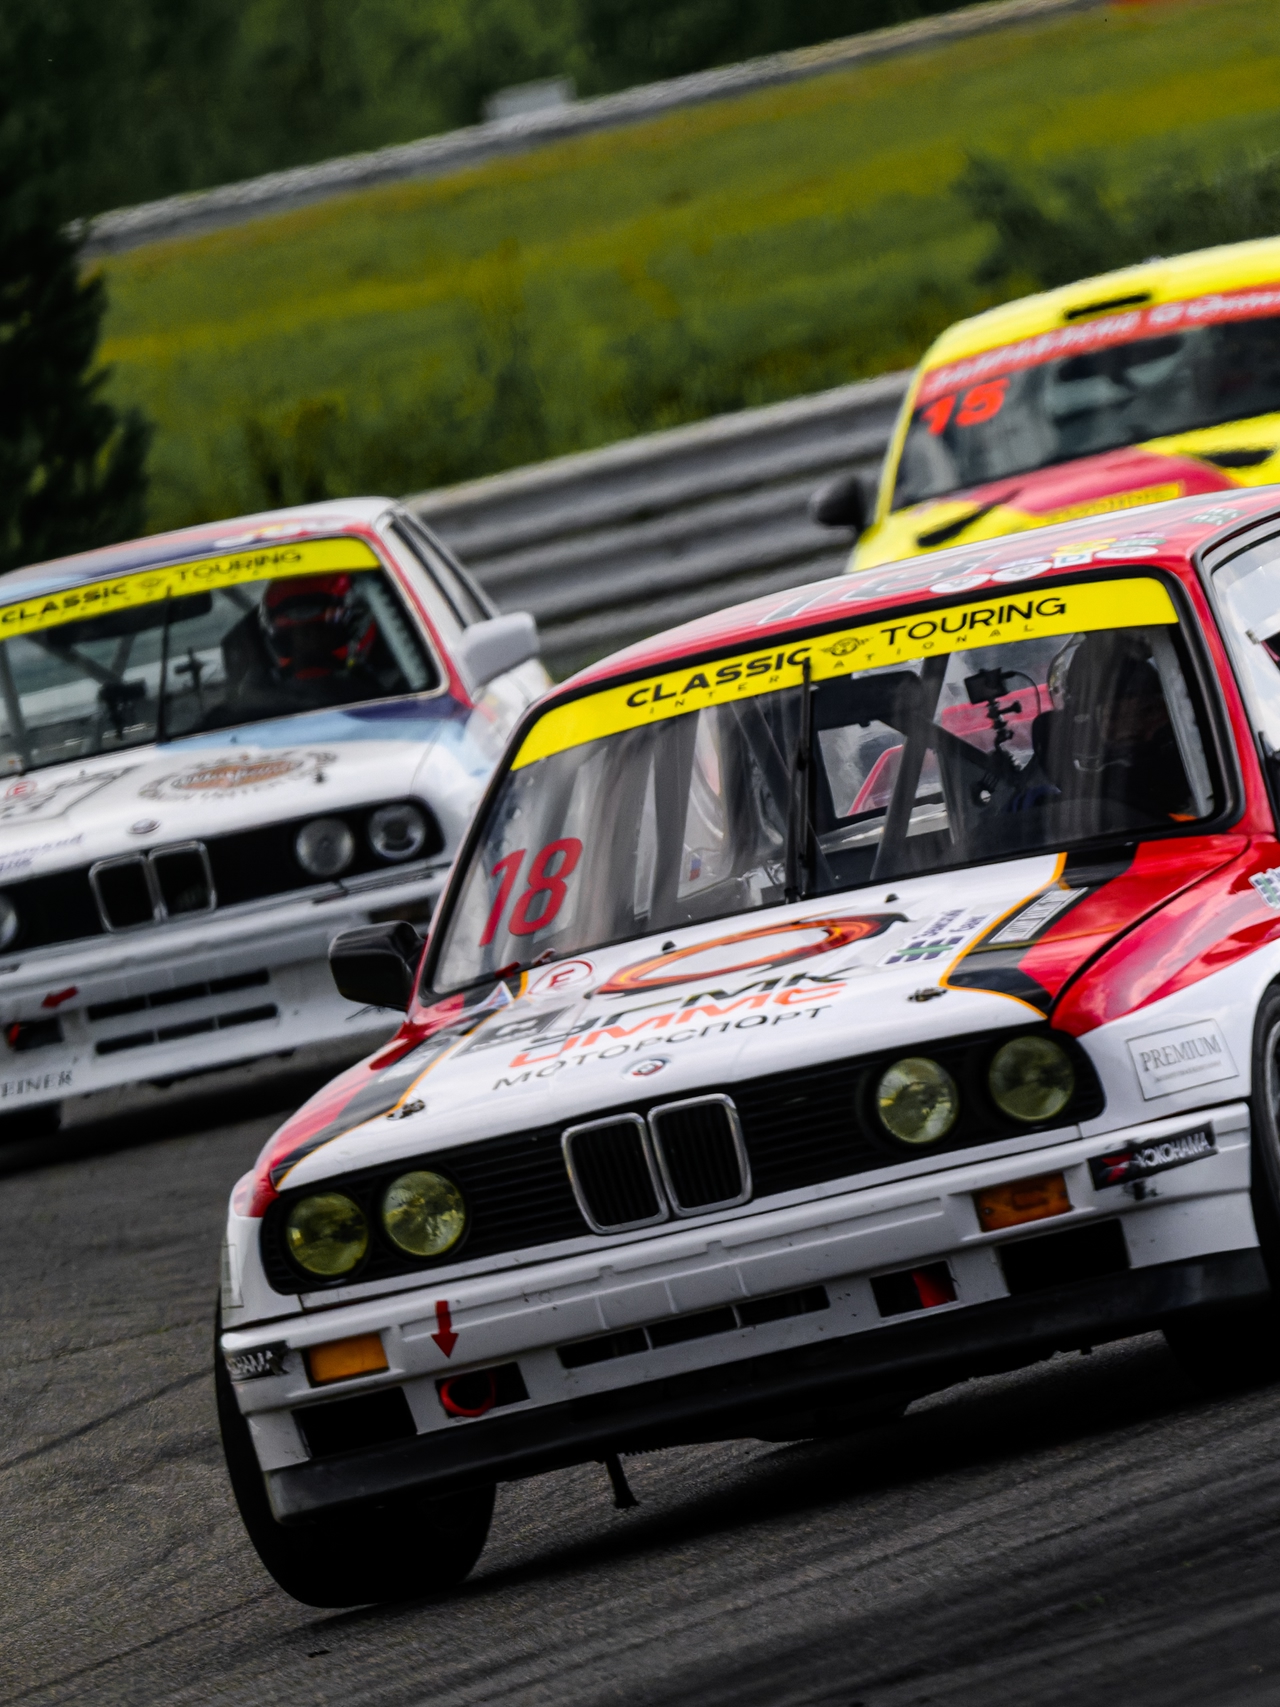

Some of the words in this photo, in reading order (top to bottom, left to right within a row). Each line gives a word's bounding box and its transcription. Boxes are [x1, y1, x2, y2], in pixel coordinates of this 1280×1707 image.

[921, 378, 1010, 435] 15
[1, 583, 128, 625] CLASSIC
[177, 550, 302, 581] TOURING
[626, 647, 811, 709] CLASSIC
[880, 597, 1067, 645] TOURING
[648, 623, 1036, 715] INTERATIONAL
[479, 838, 583, 947] 18
[492, 1005, 833, 1091] МОТОРСПОРТ
[1138, 1034, 1222, 1072] PREMIUM
[1133, 1131, 1212, 1168] YOKOHAMA
